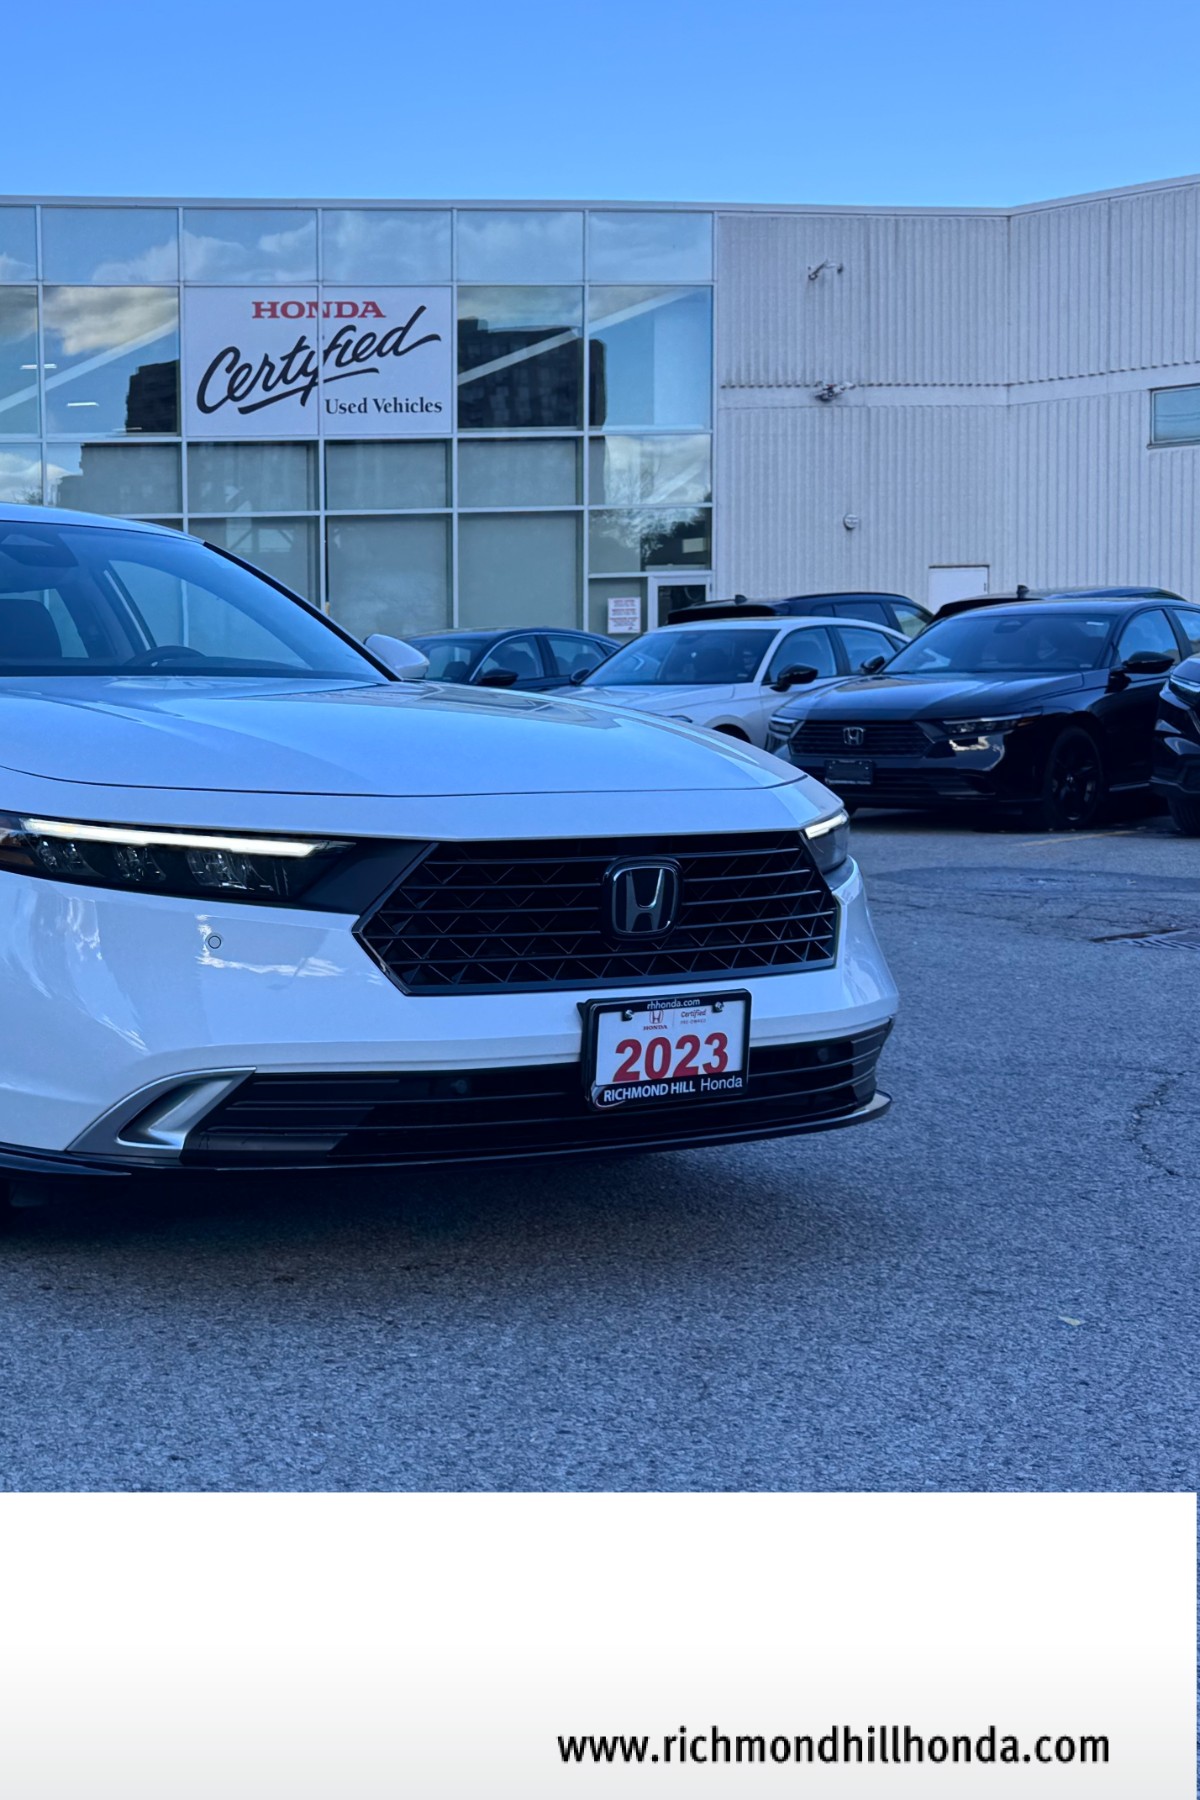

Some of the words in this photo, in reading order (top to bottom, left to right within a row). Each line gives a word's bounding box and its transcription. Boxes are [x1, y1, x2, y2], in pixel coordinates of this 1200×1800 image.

[252, 300, 386, 319] HONDA
[196, 305, 442, 415] Certified
[325, 396, 368, 415] Used
[372, 396, 443, 414] Vehicles
[646, 998, 701, 1011] rhhonda.com
[612, 1032, 729, 1083] 2023
[603, 1083, 669, 1103] RICHMOND
[670, 1081, 696, 1095] HILL
[700, 1075, 743, 1092] Honda
